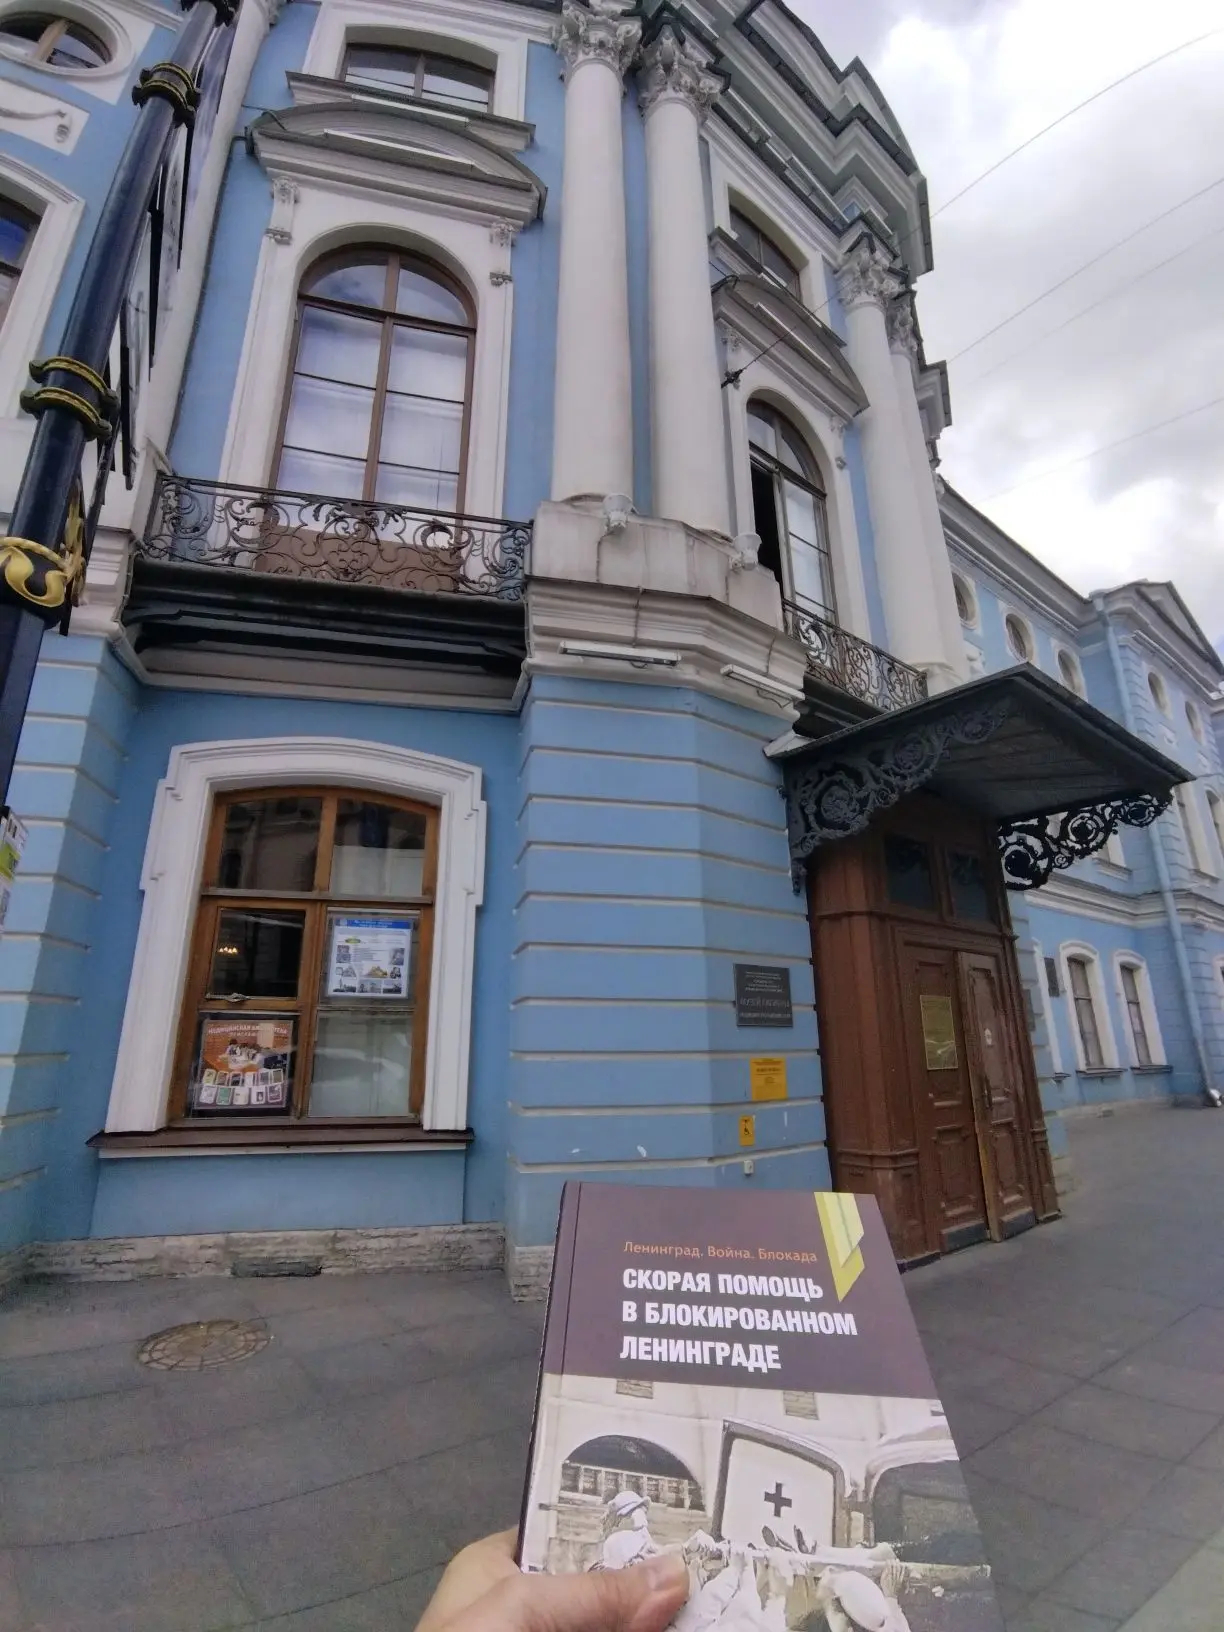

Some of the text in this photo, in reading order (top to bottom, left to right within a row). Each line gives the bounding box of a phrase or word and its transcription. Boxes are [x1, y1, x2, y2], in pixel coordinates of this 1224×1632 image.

[623, 1241, 818, 1264] Ленинград. Война. Блокада
[623, 1268, 824, 1302] СКОРАЯ ПОМОЩЬ
[622, 1301, 858, 1336] В БЛОКИРОВАННОМ
[619, 1335, 782, 1374] ЛЕНИНГРАДЕ
